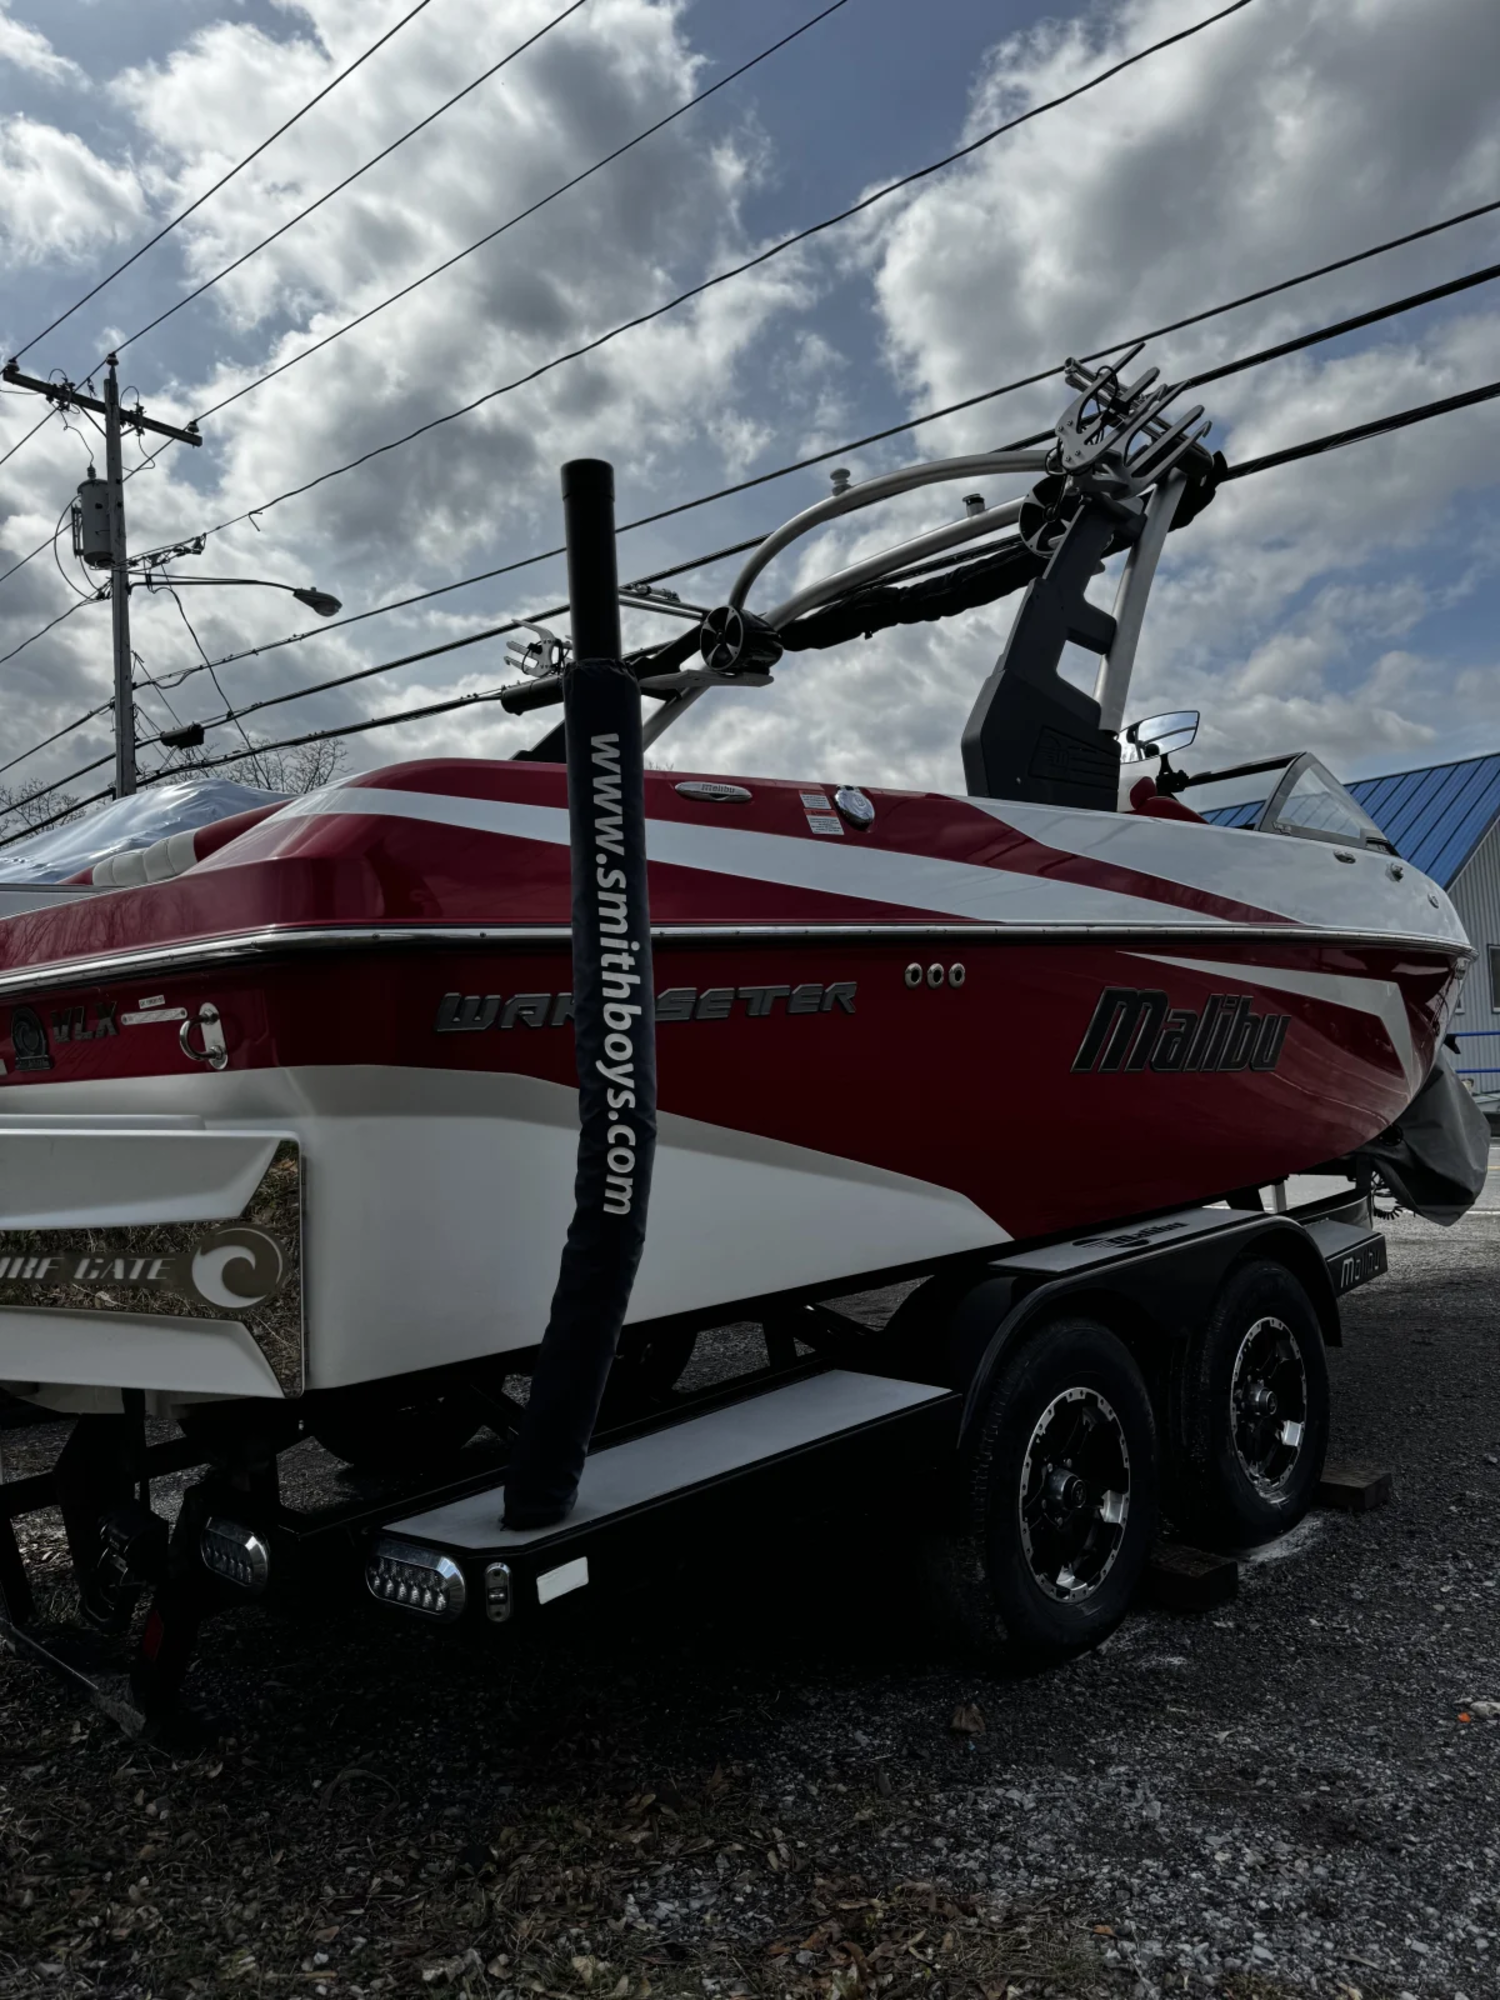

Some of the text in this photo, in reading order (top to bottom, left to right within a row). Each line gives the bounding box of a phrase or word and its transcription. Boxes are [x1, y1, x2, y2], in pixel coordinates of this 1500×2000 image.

[590, 732, 643, 1216] www.smithboys.com
[51, 1001, 118, 1042] VLX
[1069, 985, 1292, 1073] Malibu
[74, 1258, 176, 1280] GATE
